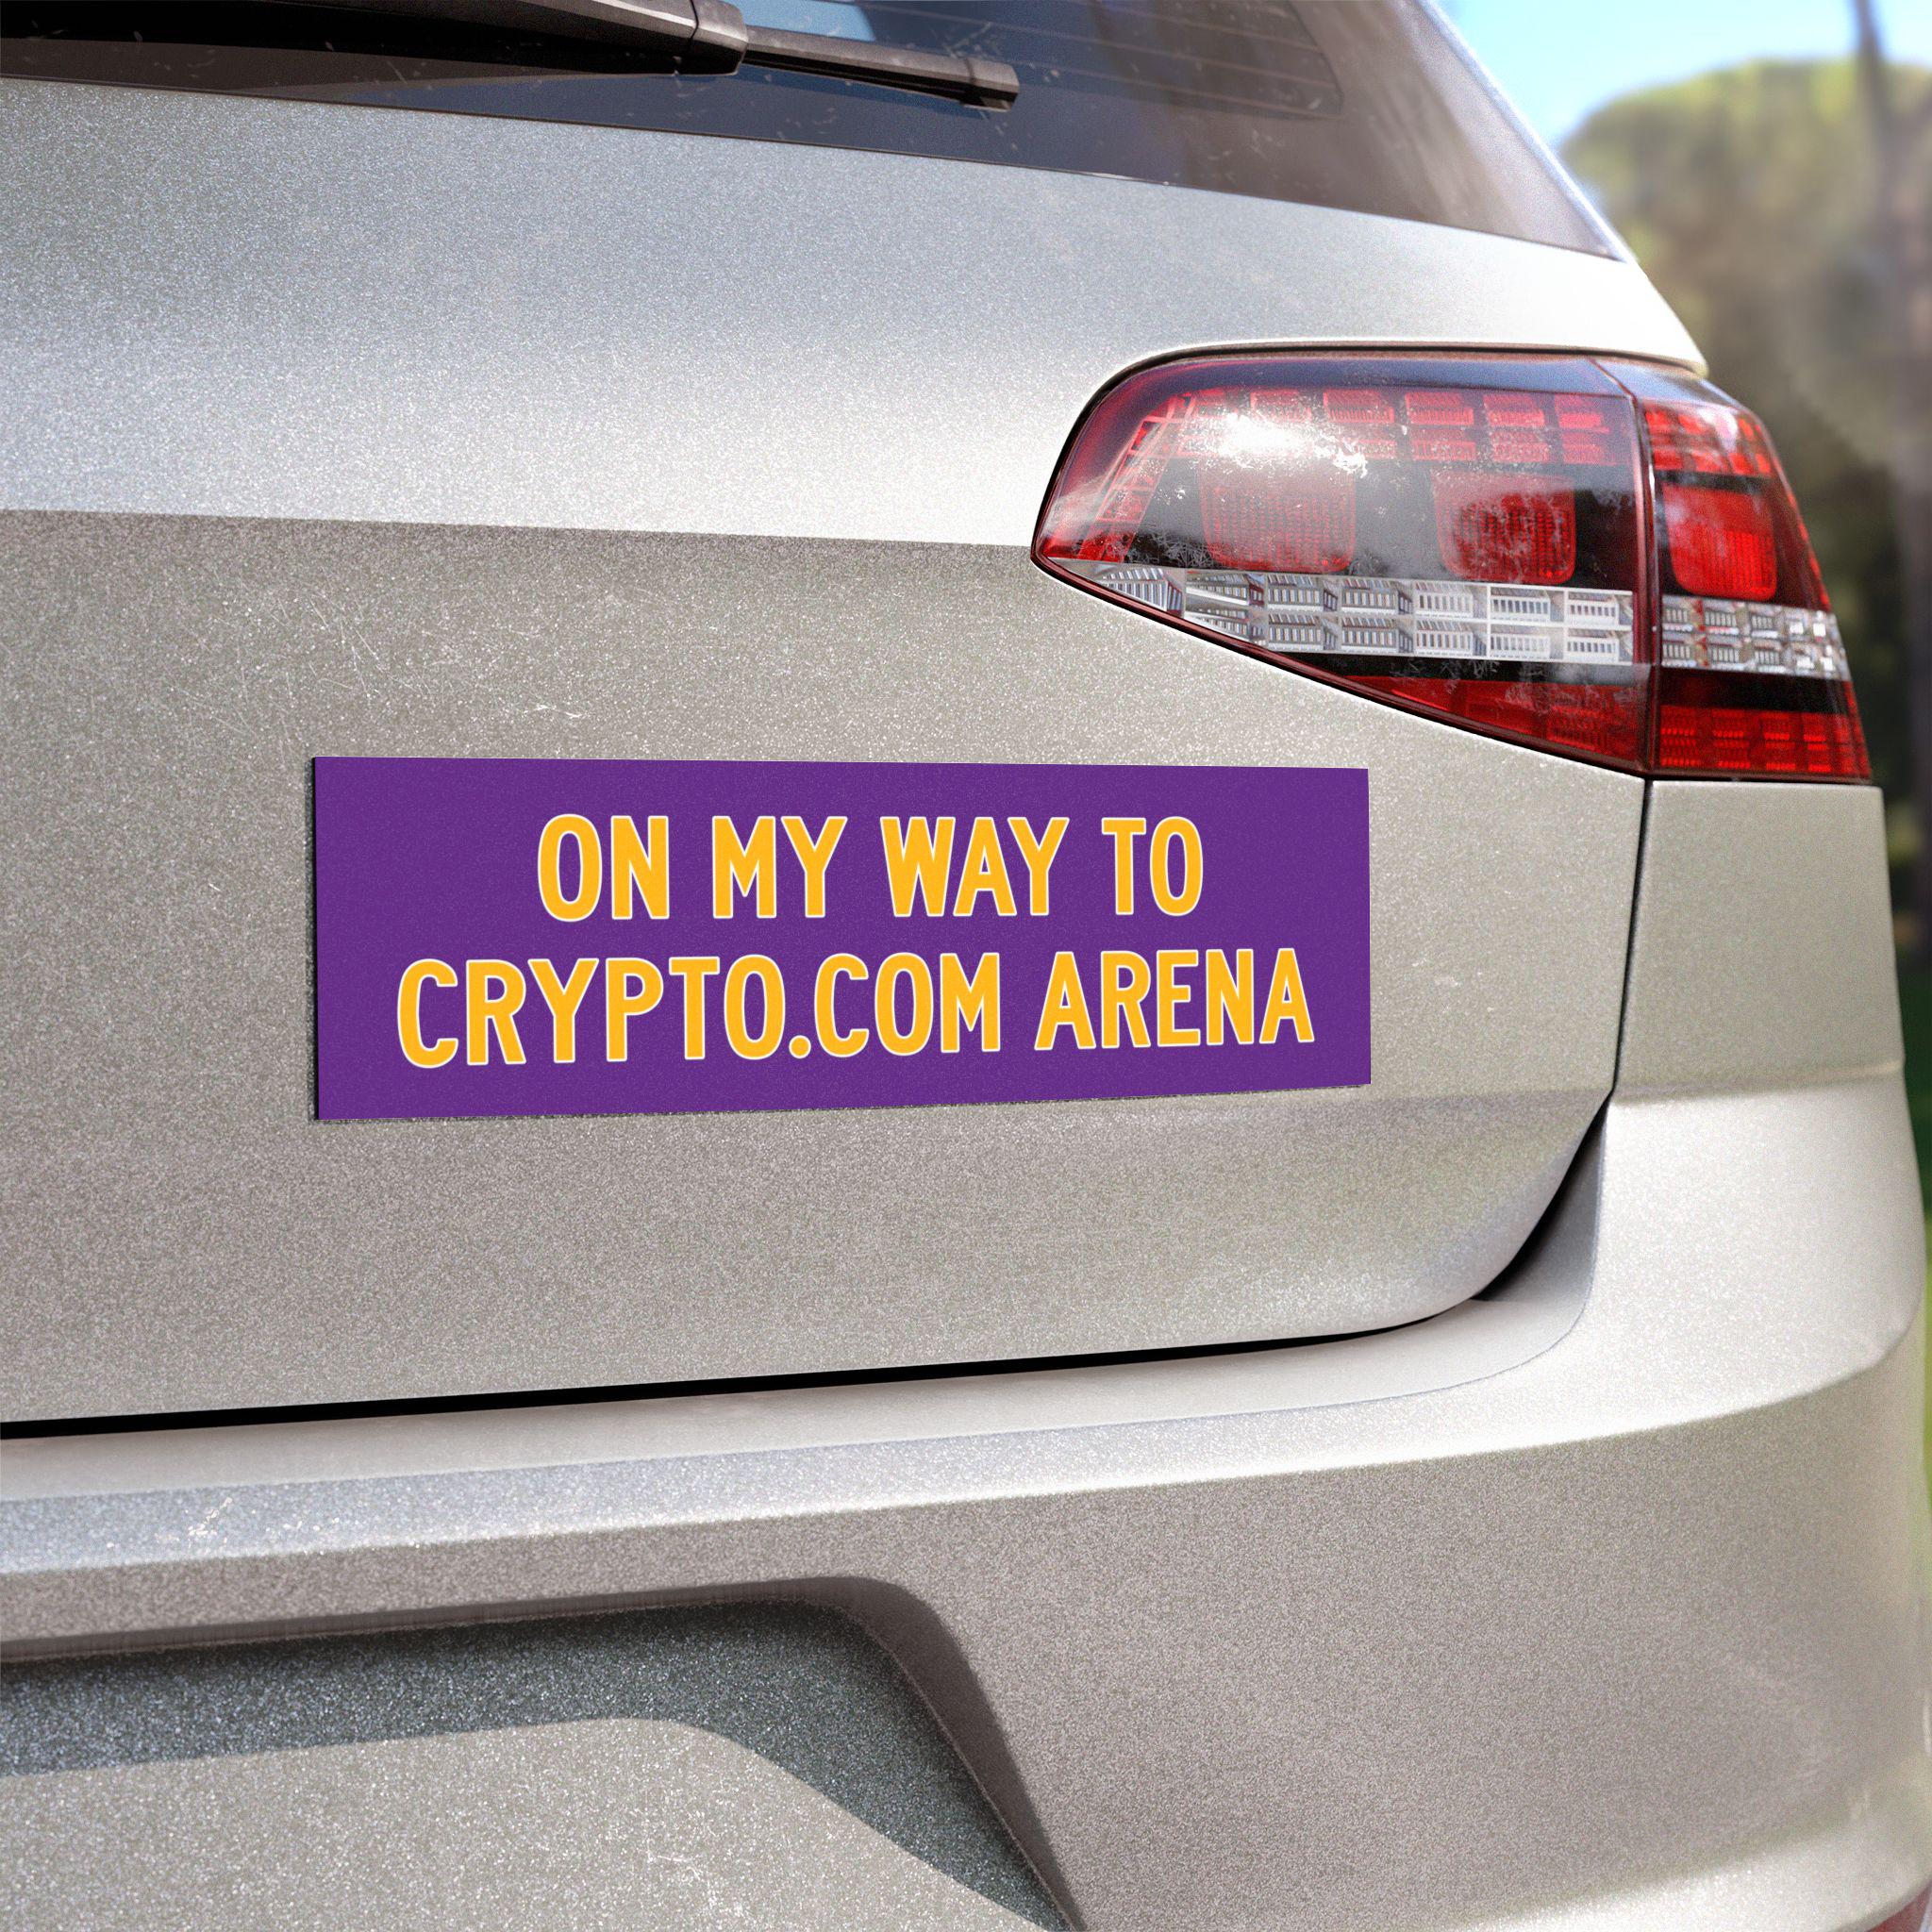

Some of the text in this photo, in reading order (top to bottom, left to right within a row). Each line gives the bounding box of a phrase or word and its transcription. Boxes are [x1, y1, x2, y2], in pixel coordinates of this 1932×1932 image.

[536, 812, 1205, 924] ON MY WAY TO
[395, 946, 1317, 1070] CRYPTO.COM ARENA
